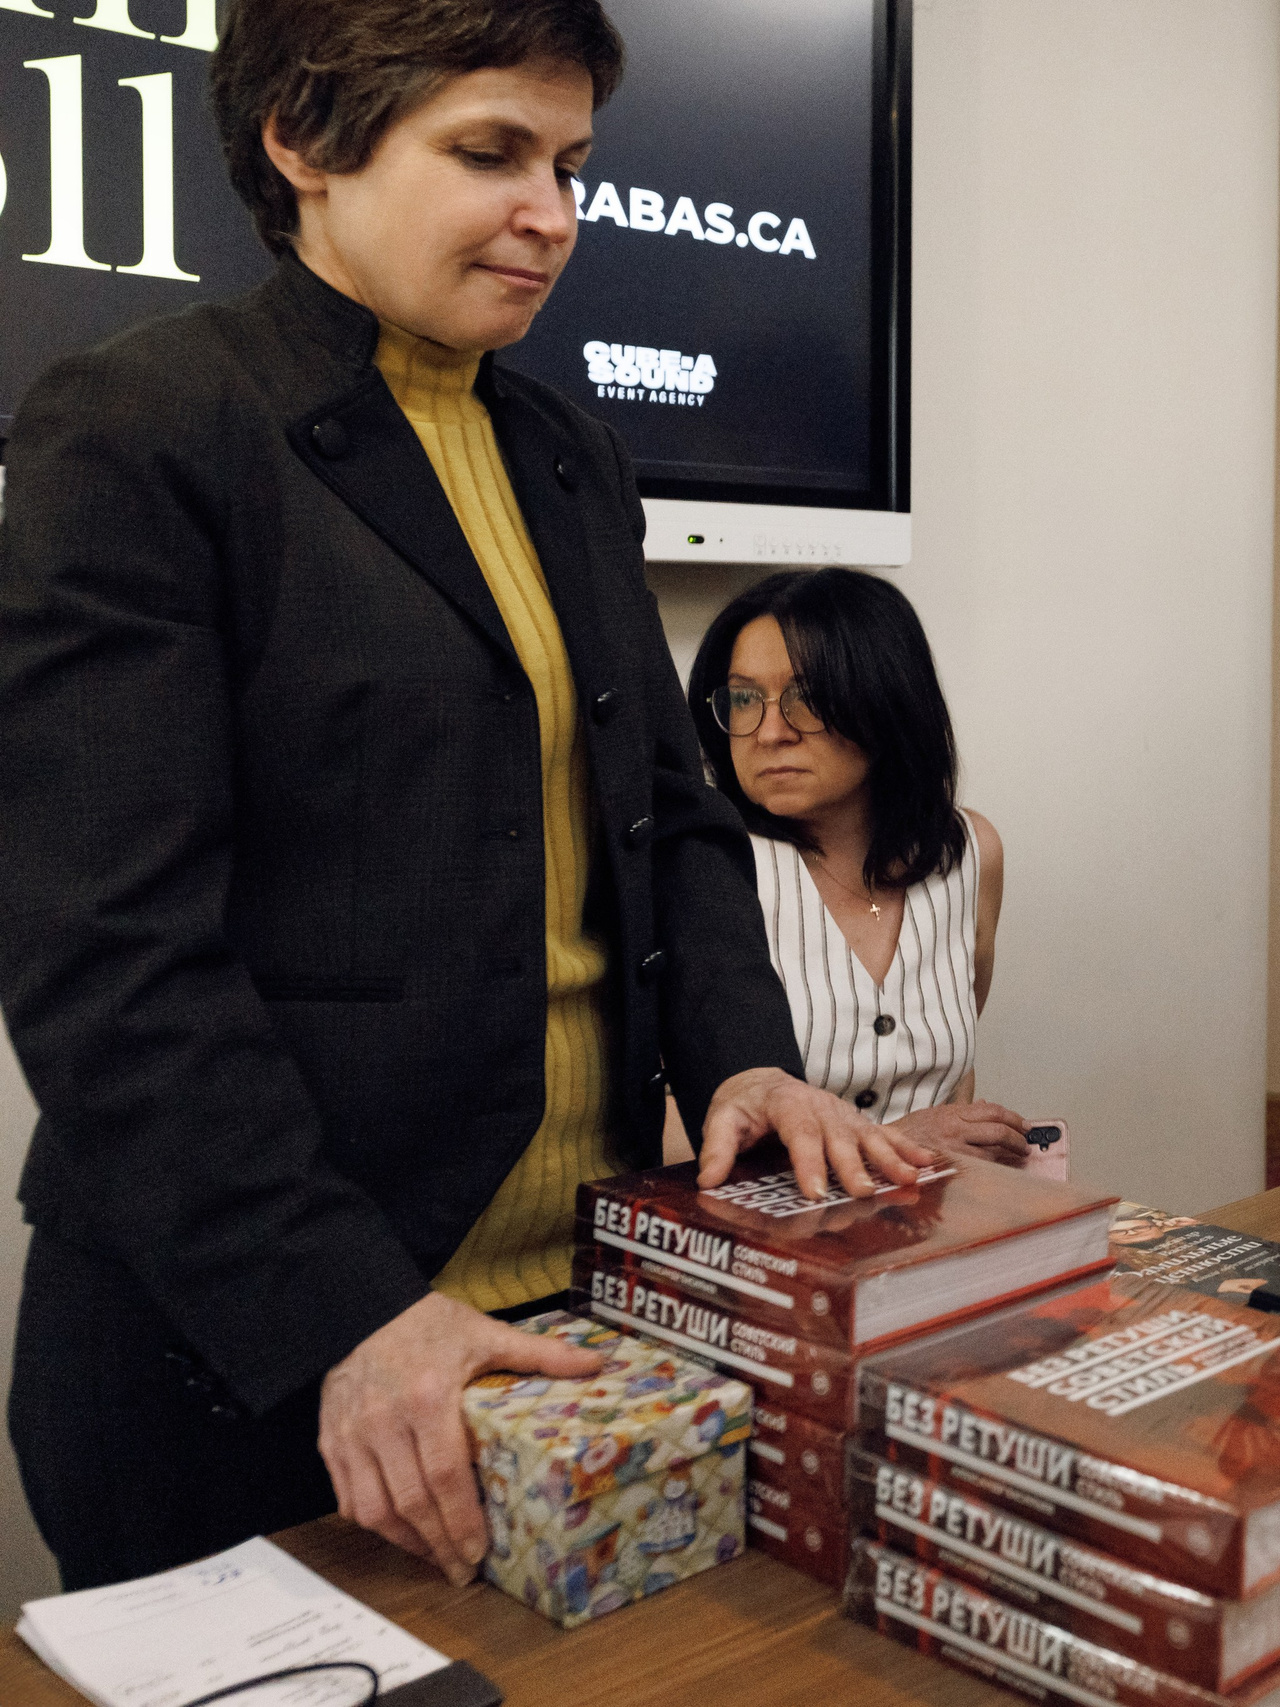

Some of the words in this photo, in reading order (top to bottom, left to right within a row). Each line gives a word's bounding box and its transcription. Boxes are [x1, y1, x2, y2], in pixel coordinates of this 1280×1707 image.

[0, 54, 200, 282] ll
[587, 360, 714, 393] SOUND
[597, 385, 645, 402] EVENT
[648, 390, 705, 407] AGENCY
[594, 1198, 631, 1235] БЕЗ
[634, 1210, 732, 1271] РЕТУШИ
[733, 1244, 798, 1277] СОВЕТСКИЙ
[732, 1261, 768, 1285] СТИЛЬ
[592, 1271, 628, 1309] БЕЗ
[631, 1286, 730, 1348] РЕТУШИ
[730, 1338, 767, 1362] СТИЛЬ
[732, 1321, 798, 1355] СОВЕТСКИЙ
[886, 1383, 936, 1435] БЕЗ
[941, 1406, 1079, 1490] РЕТУШИ
[876, 1466, 925, 1517] БЕЗ
[929, 1489, 1060, 1576] РЕТУШИ
[876, 1559, 925, 1611] БЕЗ
[932, 1583, 1073, 1675] РЕТУШИ
